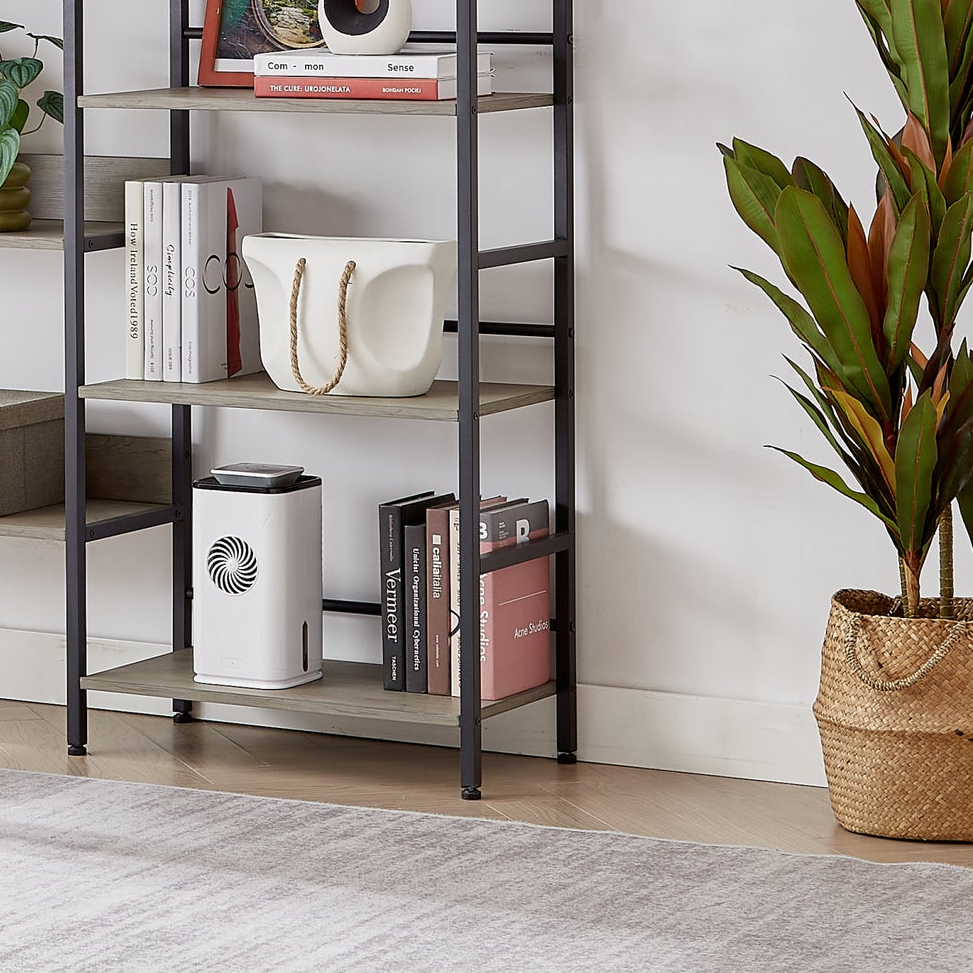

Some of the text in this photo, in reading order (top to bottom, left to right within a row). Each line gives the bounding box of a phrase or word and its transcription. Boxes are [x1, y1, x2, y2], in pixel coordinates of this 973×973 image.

[267, 62, 288, 70] Com
[387, 63, 414, 72] Sense
[130, 223, 138, 246] How
[147, 265, 158, 296] COS
[165, 244, 175, 296] Simplicity
[185, 267, 196, 298] COS
[386, 567, 401, 643] Vermeer
[412, 575, 420, 627] Organizational
[514, 620, 549, 639] Acne Studios
[412, 630, 420, 671] Cybernetics
